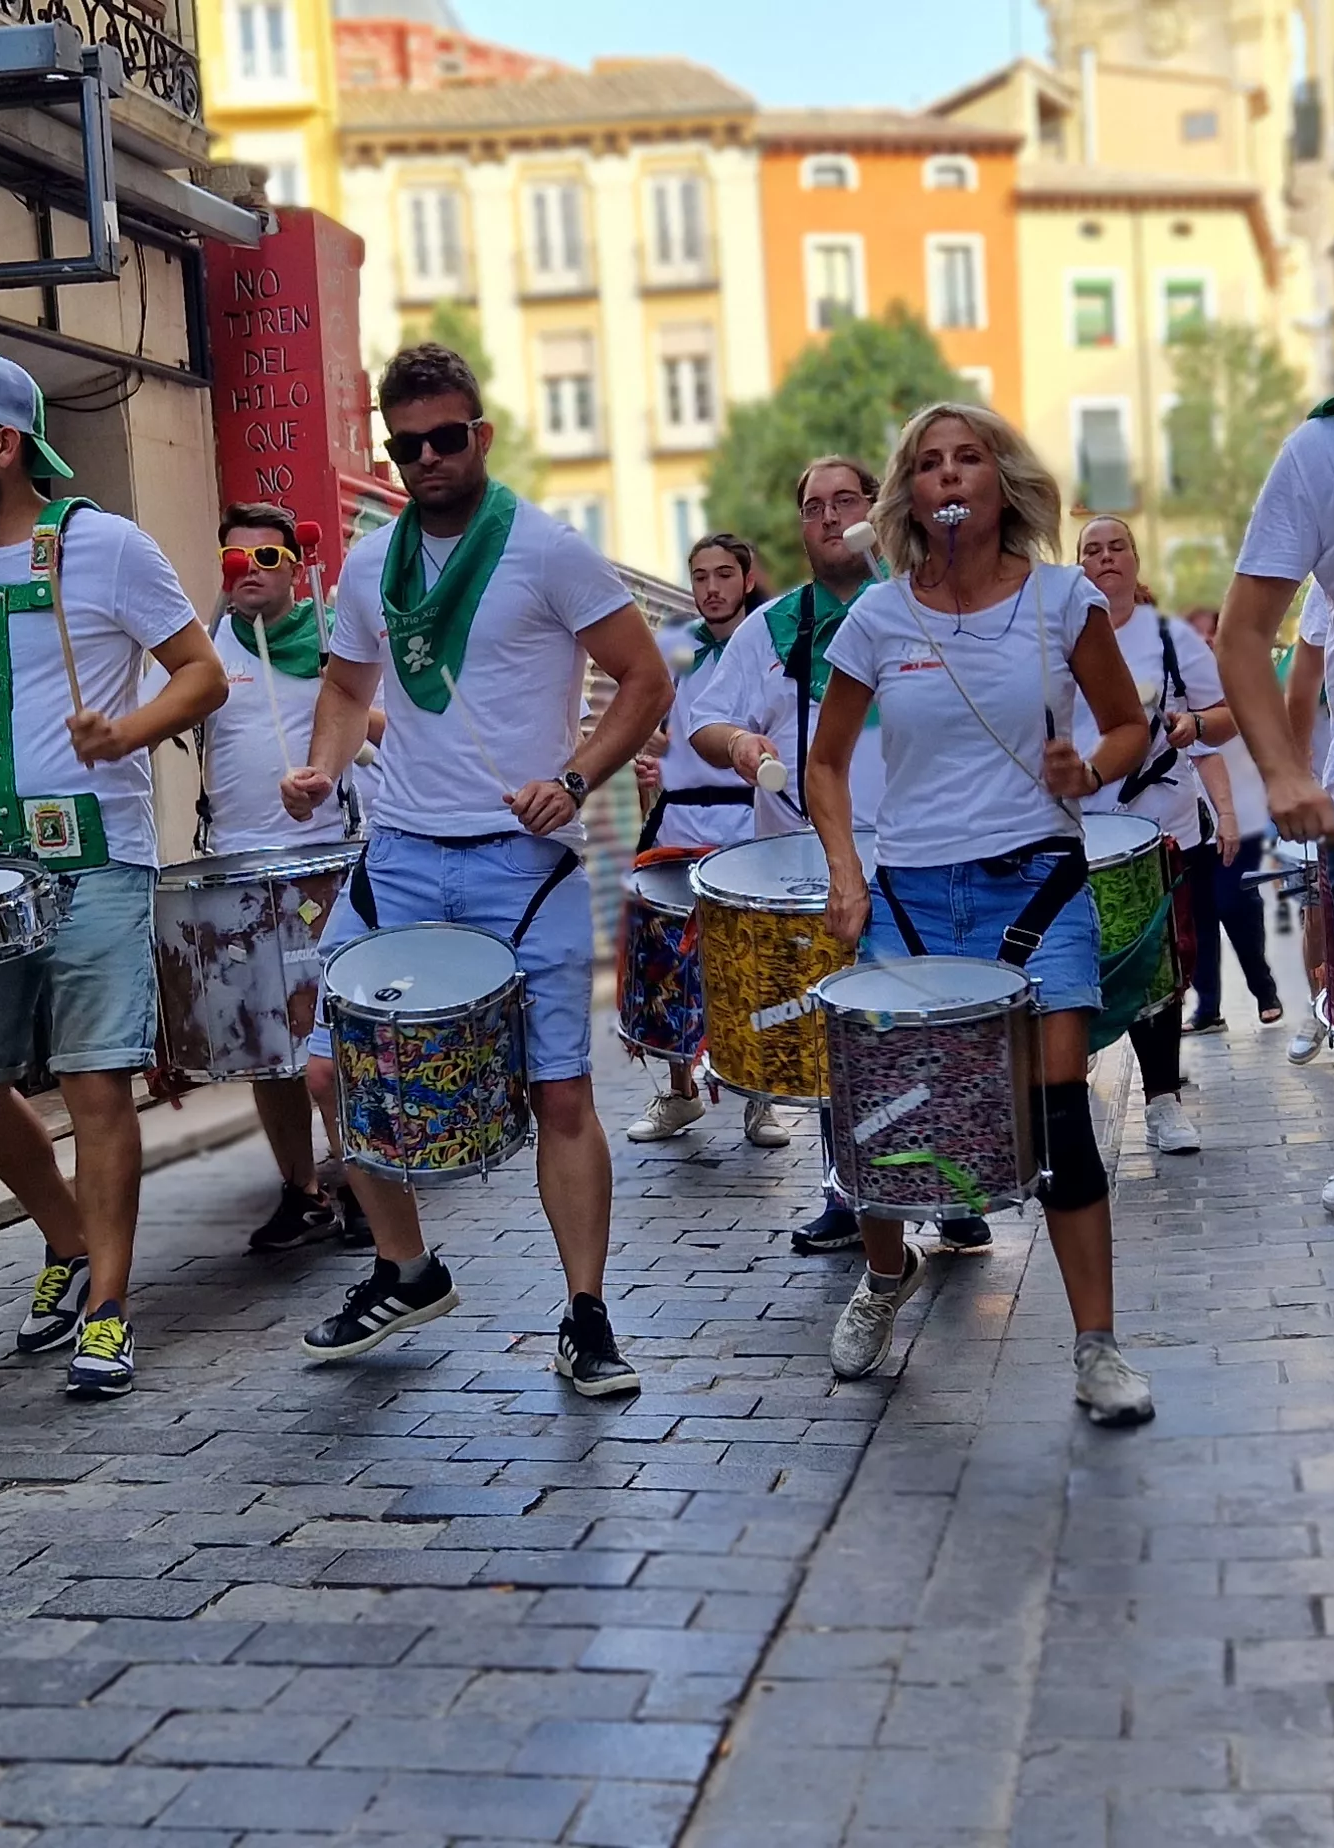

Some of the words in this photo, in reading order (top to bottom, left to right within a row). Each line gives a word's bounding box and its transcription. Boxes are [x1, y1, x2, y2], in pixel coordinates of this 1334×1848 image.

[234, 267, 280, 301] NO
[222, 304, 310, 339] TIREN
[243, 346, 299, 378] DEL
[231, 381, 310, 413] HILO
[245, 420, 300, 453] QUE
[255, 463, 294, 495] NO
[259, 496, 298, 520] S
